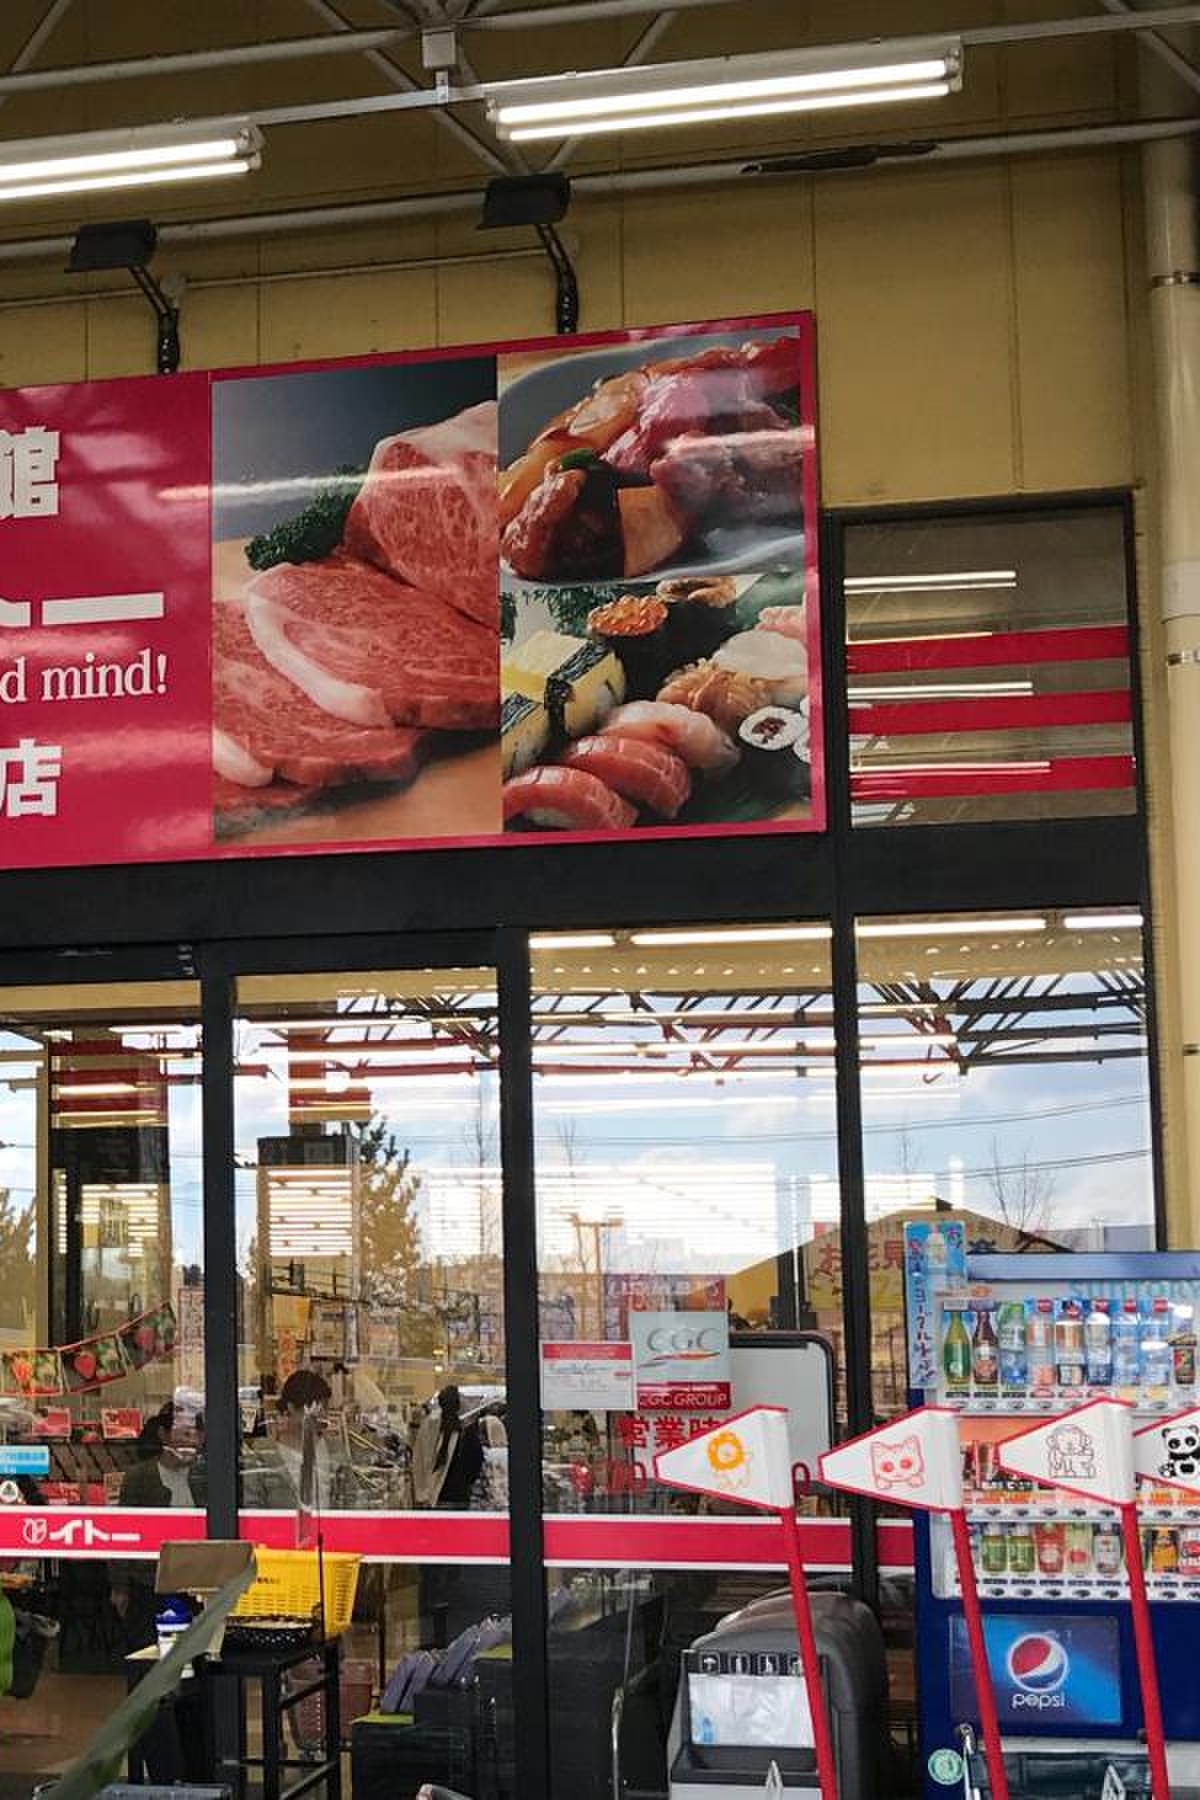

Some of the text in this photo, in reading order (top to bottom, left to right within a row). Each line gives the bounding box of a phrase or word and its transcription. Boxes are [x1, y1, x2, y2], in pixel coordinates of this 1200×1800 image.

[41, 649, 168, 699] mind!
[647, 1327, 721, 1353] CGC
[673, 1389, 728, 1407] GROUP
[50, 1519, 140, 1545] イトー
[1011, 1691, 1065, 1711] pepsi
